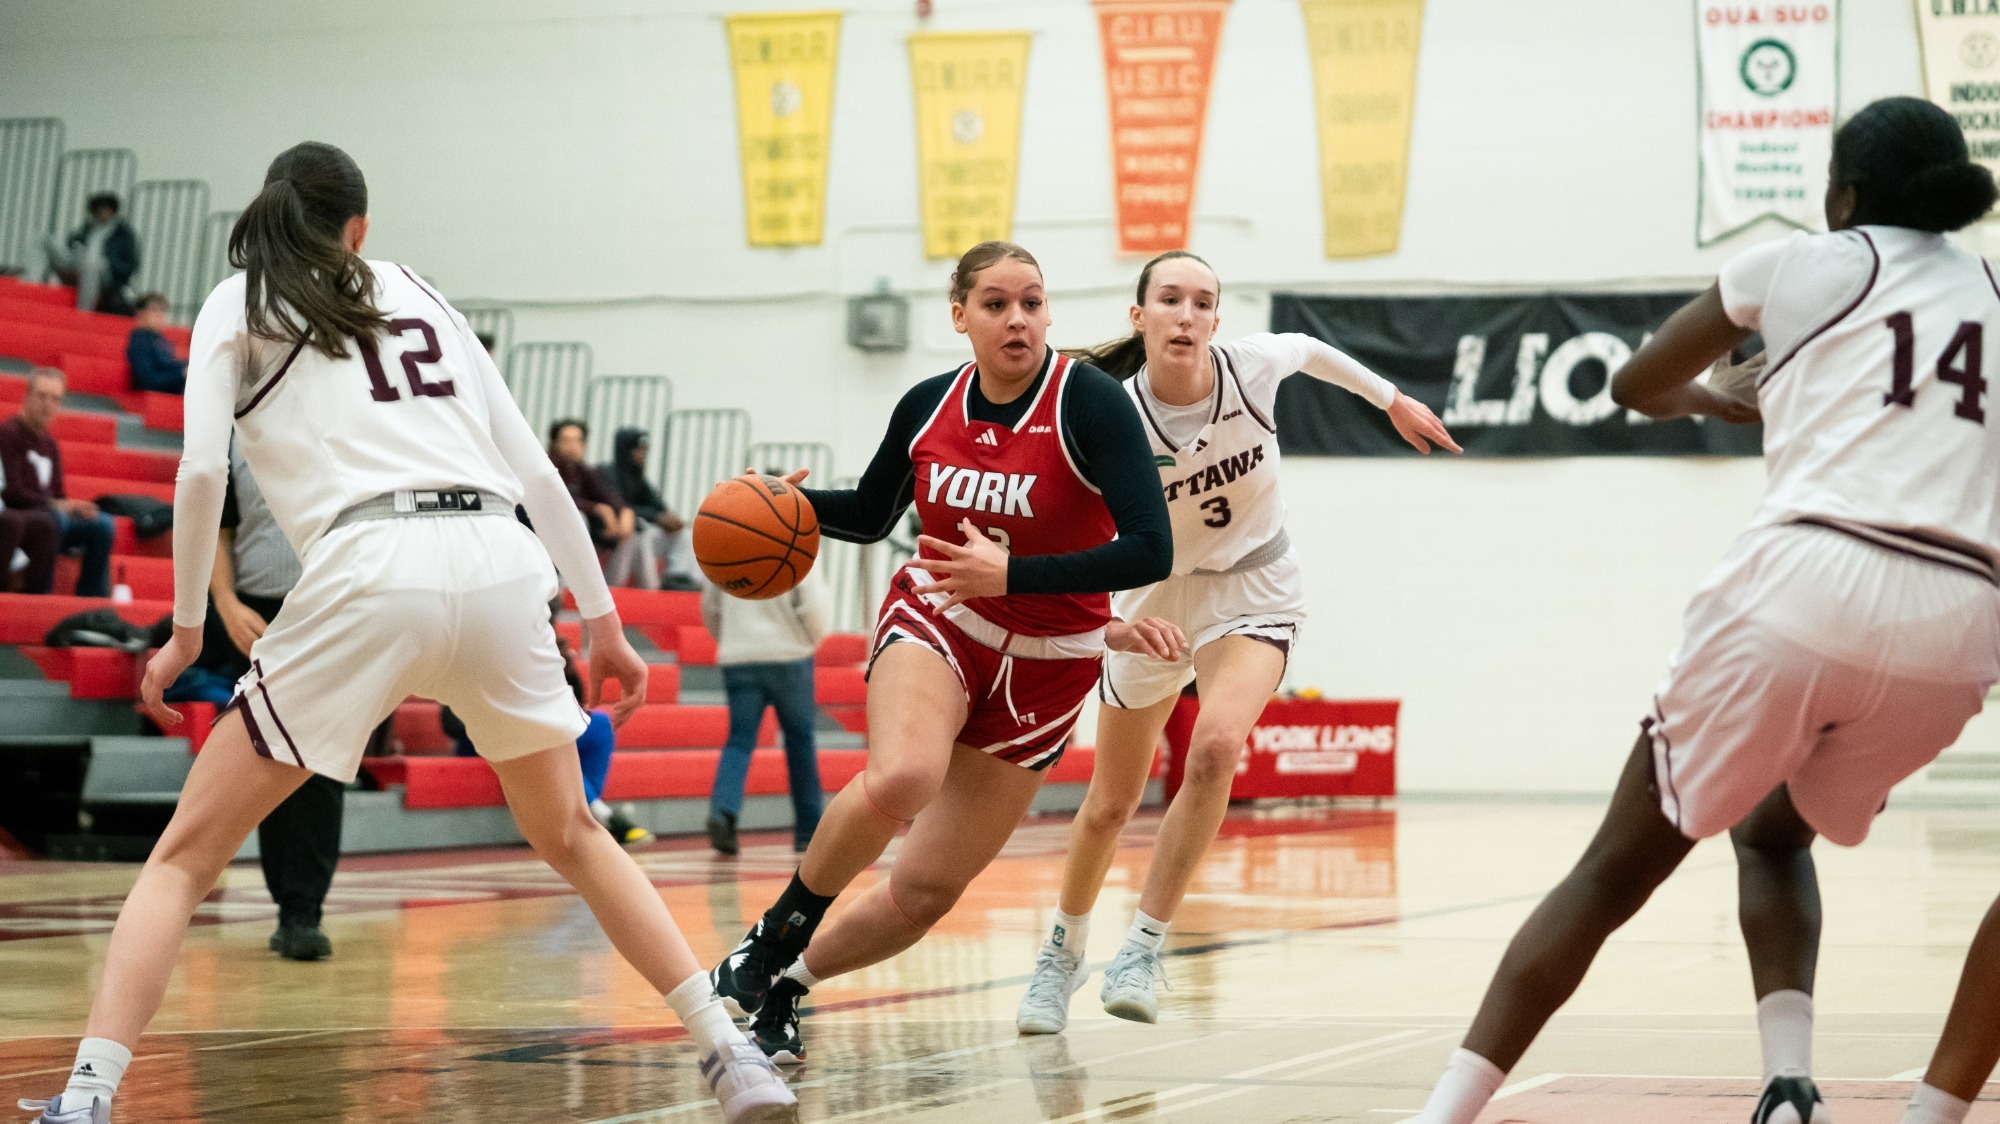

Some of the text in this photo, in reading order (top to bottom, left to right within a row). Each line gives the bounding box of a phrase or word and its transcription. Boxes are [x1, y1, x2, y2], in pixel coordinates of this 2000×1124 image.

[1706, 107, 1831, 130] CHAMPIONS
[357, 318, 456, 402] 12
[1442, 330, 1706, 428] LIO
[1883, 310, 1987, 426] 14
[927, 462, 1038, 518] YORK
[1164, 444, 1264, 502] TTAWA
[1200, 495, 1231, 528] 3
[1252, 725, 1394, 753] YORK LIONS
